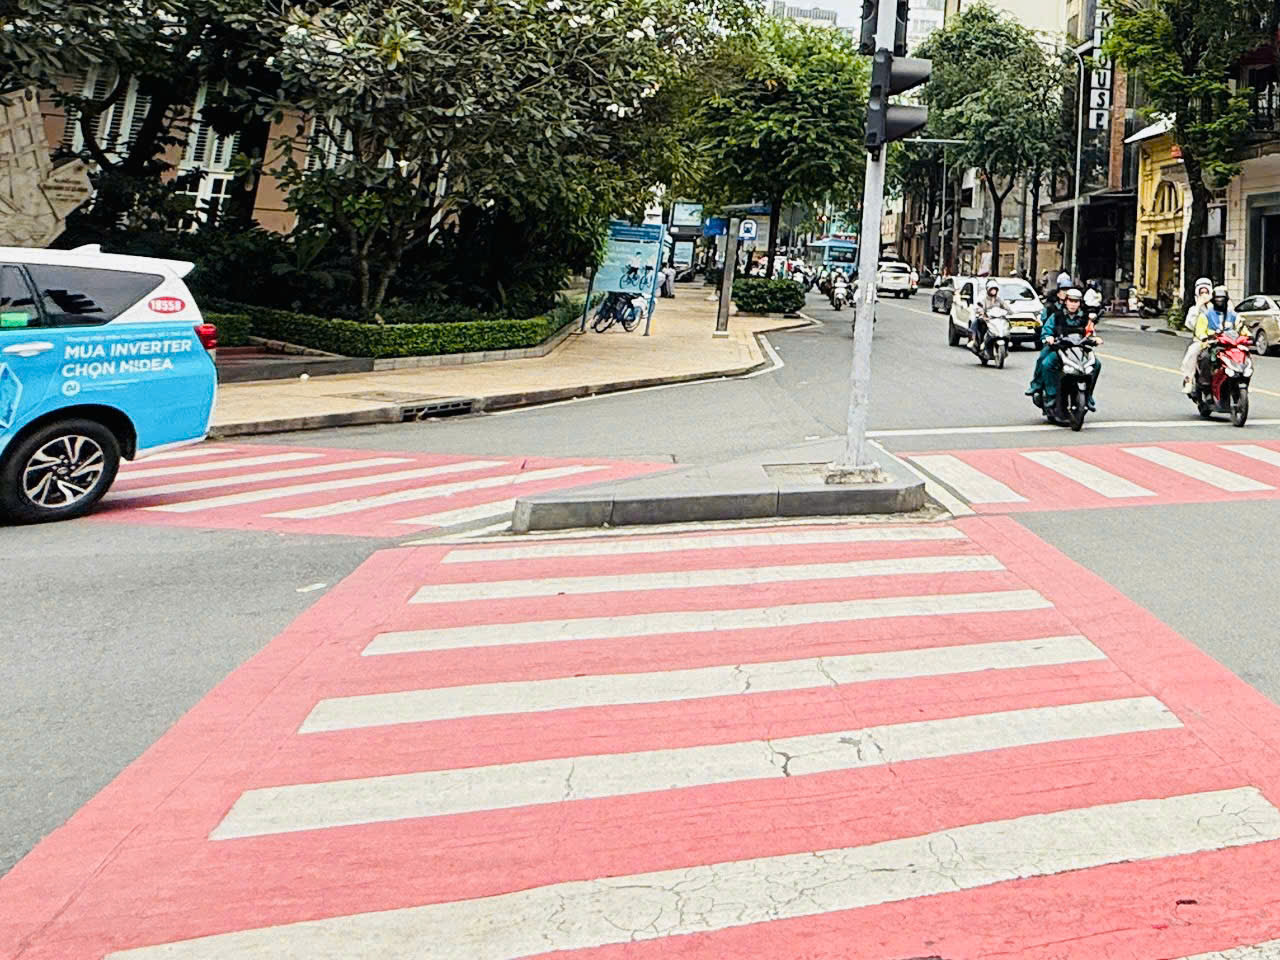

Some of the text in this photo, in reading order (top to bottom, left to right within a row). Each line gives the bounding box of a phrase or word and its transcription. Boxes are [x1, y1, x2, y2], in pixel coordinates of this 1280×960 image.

[64, 339, 193, 360] MUA INVERTER
[62, 357, 174, 379] CHỌN MIDEA
